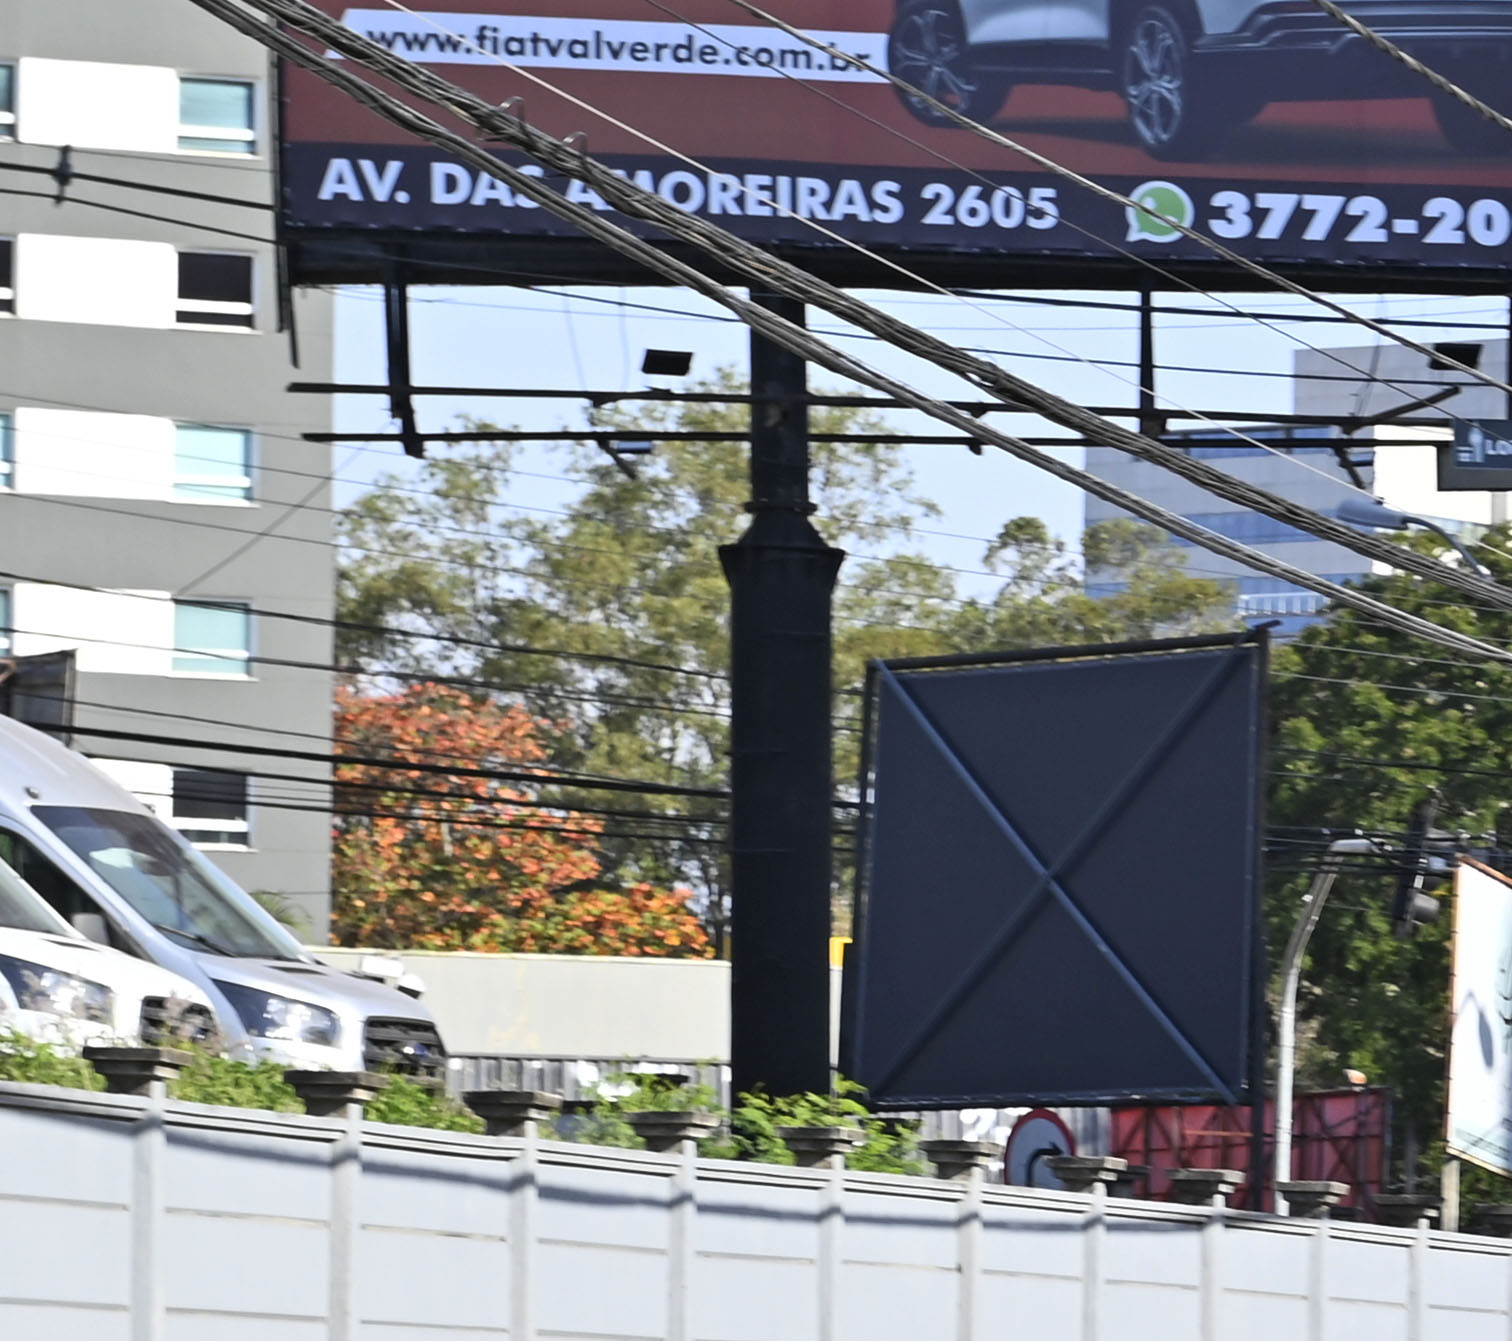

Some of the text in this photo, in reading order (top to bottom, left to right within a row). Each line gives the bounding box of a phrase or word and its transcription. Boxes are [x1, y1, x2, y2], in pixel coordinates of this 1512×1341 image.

[366, 25, 871, 71] www.fiatvalverde.com.br
[318, 156, 410, 204] AV.
[920, 181, 1059, 230] 2605
